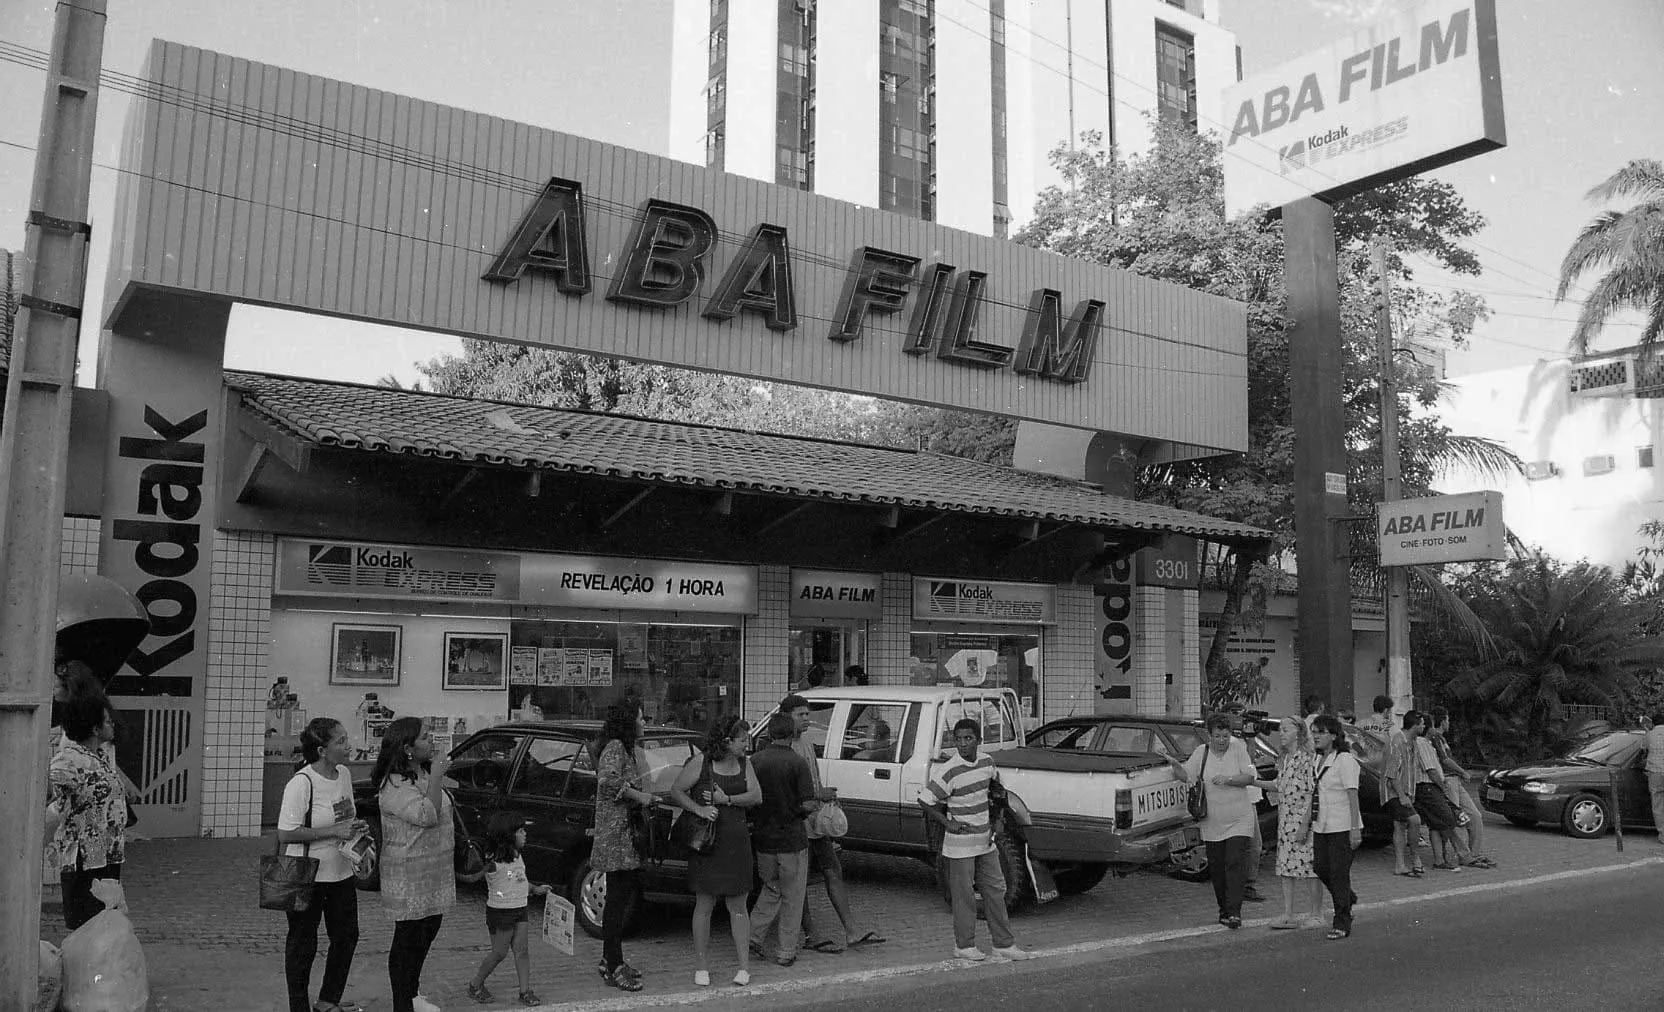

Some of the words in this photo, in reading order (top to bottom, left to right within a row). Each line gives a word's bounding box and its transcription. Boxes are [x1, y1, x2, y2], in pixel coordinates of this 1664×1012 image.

[1227, 72, 1325, 147] ABA
[1338, 8, 1470, 104] FILM
[1307, 124, 1349, 151] Kodak
[1325, 115, 1409, 160] EXPRESS
[480, 176, 798, 331] ABA
[828, 245, 1106, 384] FILM
[1383, 515, 1426, 536] ABA
[1430, 508, 1485, 531] FILM
[106, 403, 208, 697] Kodak
[356, 547, 414, 570] Kodak
[383, 569, 497, 591] EXPRESS
[1155, 559, 1188, 580] 3301
[560, 571, 654, 595] REVELAÇÃO
[665, 577, 673, 594] 1
[679, 579, 725, 597] HORA
[800, 585, 835, 601] ABA
[839, 587, 875, 602] FILM
[958, 583, 993, 600] Kodak
[974, 600, 1043, 617] EXPRESS
[1138, 782, 1193, 814] MITSUBISH
